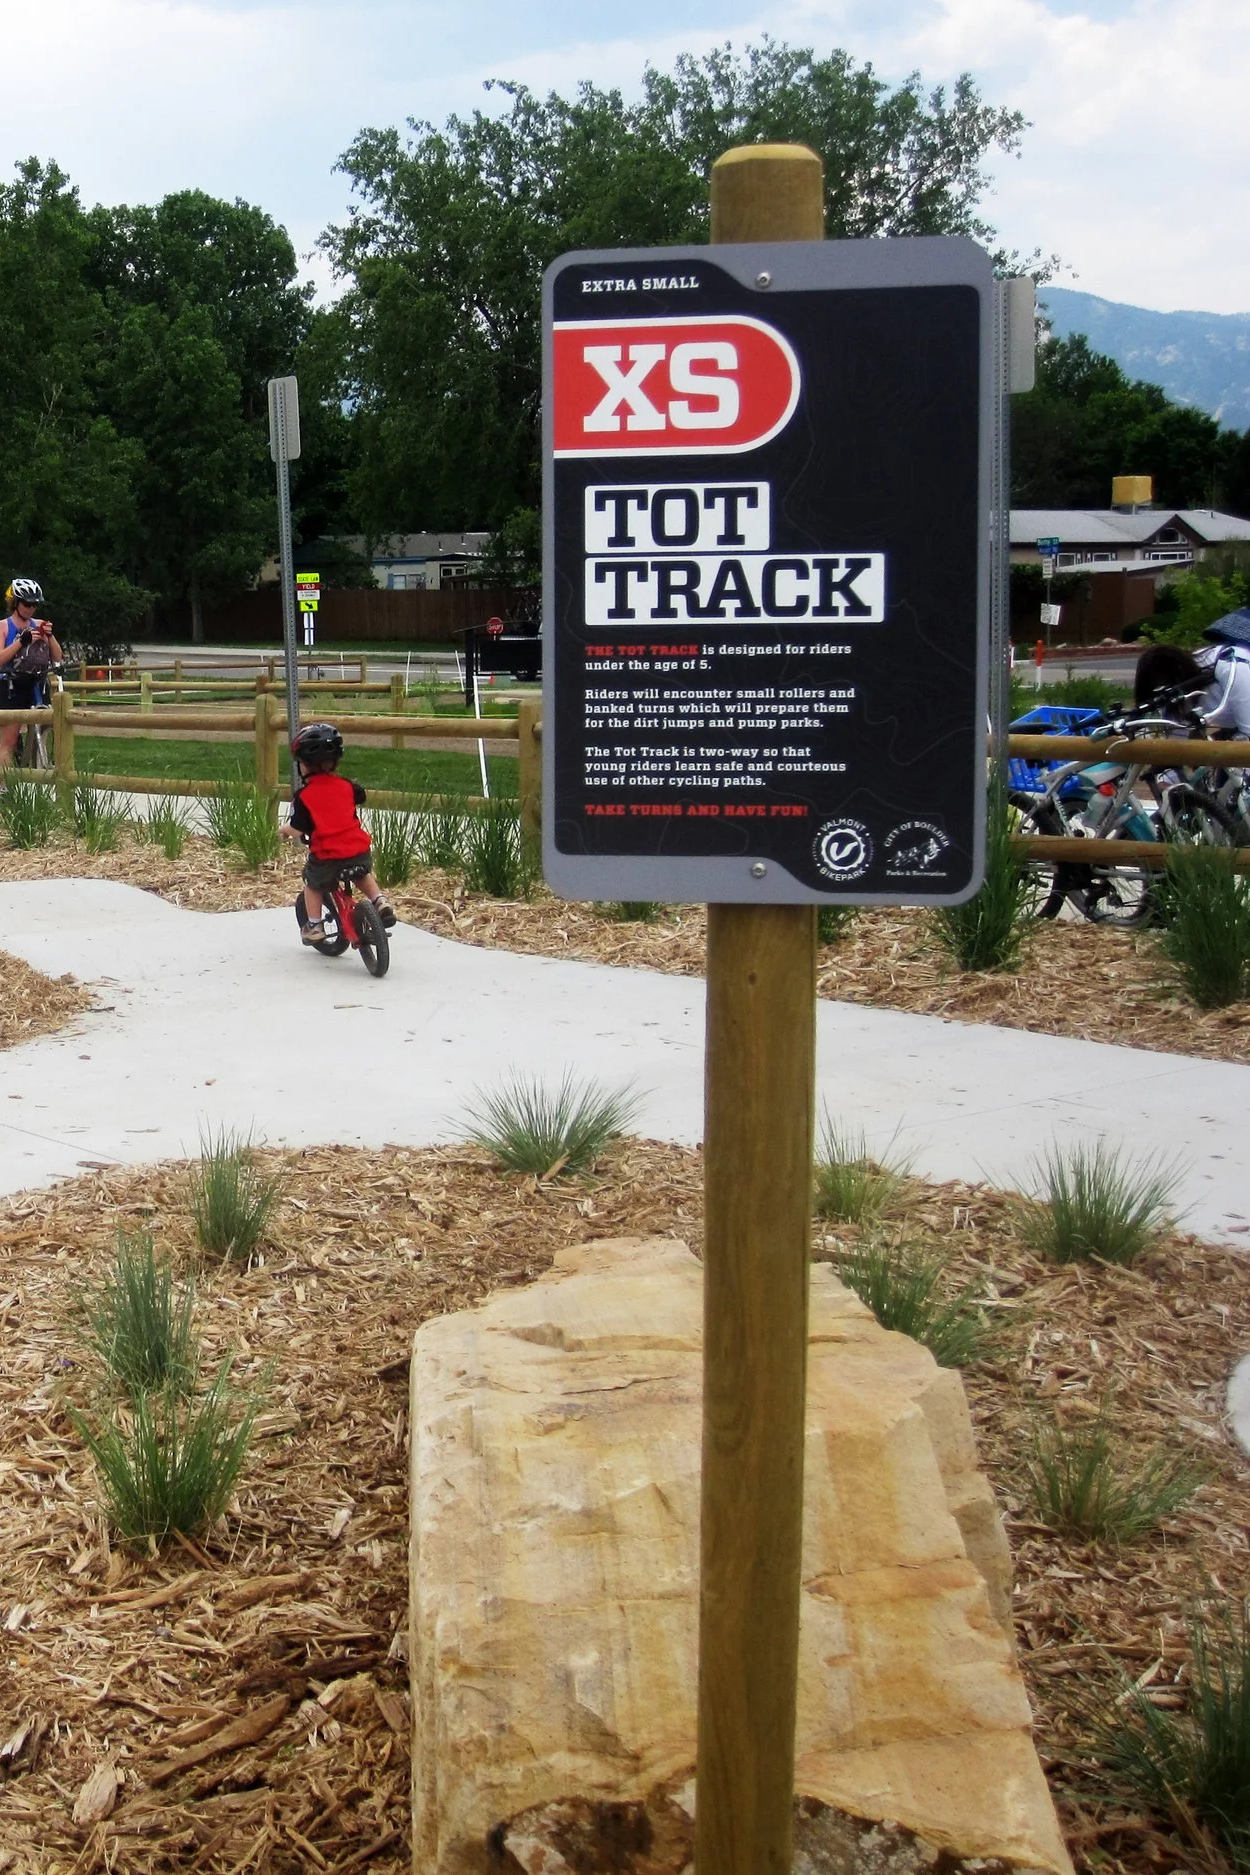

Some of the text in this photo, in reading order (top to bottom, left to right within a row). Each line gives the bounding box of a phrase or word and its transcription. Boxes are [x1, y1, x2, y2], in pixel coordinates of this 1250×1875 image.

[581, 276, 700, 293] EXTRA SMALL
[583, 341, 740, 433] XS
[594, 486, 759, 549] TOT
[594, 557, 872, 619] TRACK
[585, 643, 852, 658] THE TOT TRACK is designed for riders
[584, 659, 712, 673] under the age of 5.
[584, 687, 856, 700] Riders will encounter small rollers and
[584, 702, 850, 716] banked turns which will prepare them
[584, 716, 824, 731] for the dirt jumps and pump parks.
[584, 746, 812, 760] The Tot Track is two-way so that
[584, 760, 847, 774] young riders learn safe and courteous
[584, 774, 766, 788] use of other cycling paths.
[584, 803, 809, 817] TAKE TURNS AND HAVE FUN!
[819, 818, 866, 832] VALMONT
[884, 821, 950, 847] CITY OF BOULDER
[819, 866, 867, 881] BIKEPARK
